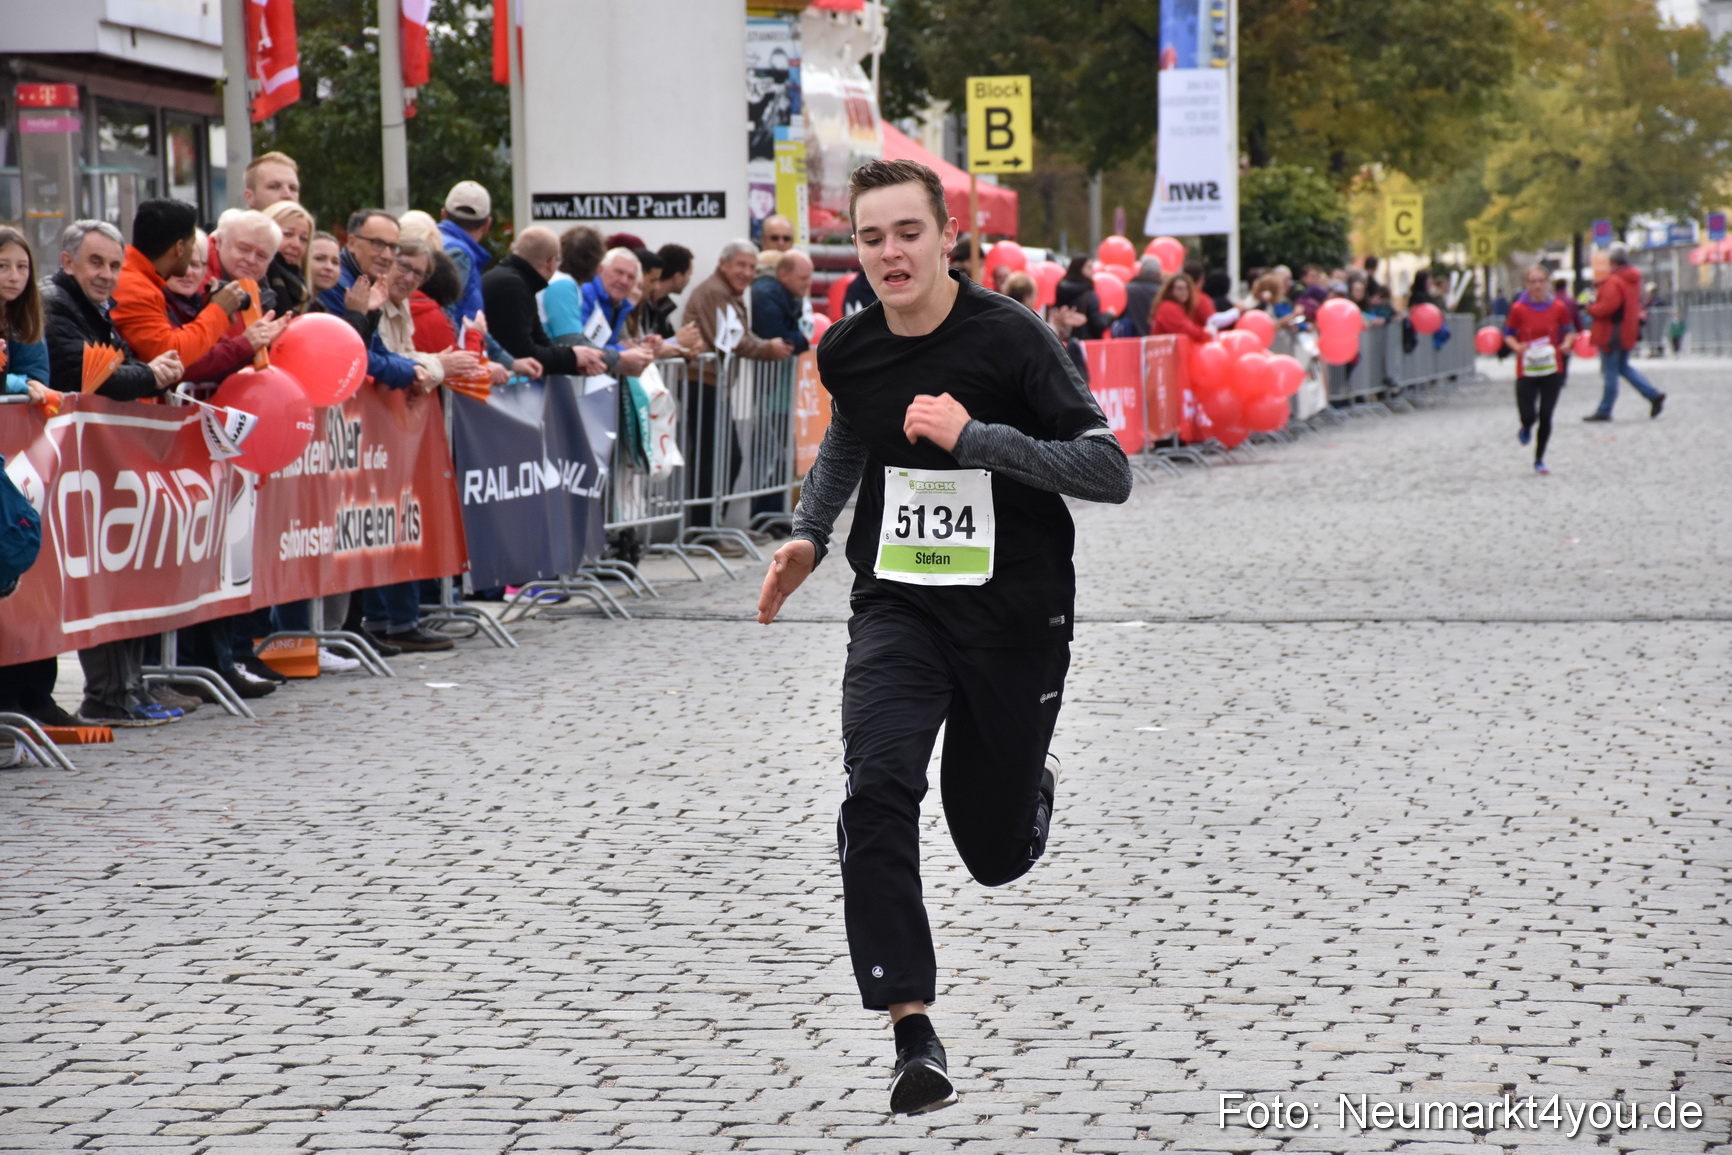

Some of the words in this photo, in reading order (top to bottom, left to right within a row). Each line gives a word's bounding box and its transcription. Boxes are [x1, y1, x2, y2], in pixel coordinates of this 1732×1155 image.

[975, 82, 1023, 98] Block
[986, 107, 1014, 151] B
[532, 194, 720, 219] www.MINI-Partl.de
[1394, 211, 1413, 236] C
[1477, 237, 1491, 256] D
[915, 481, 956, 491] BOCK
[895, 505, 976, 540] 5134
[915, 552, 951, 565] Stefan
